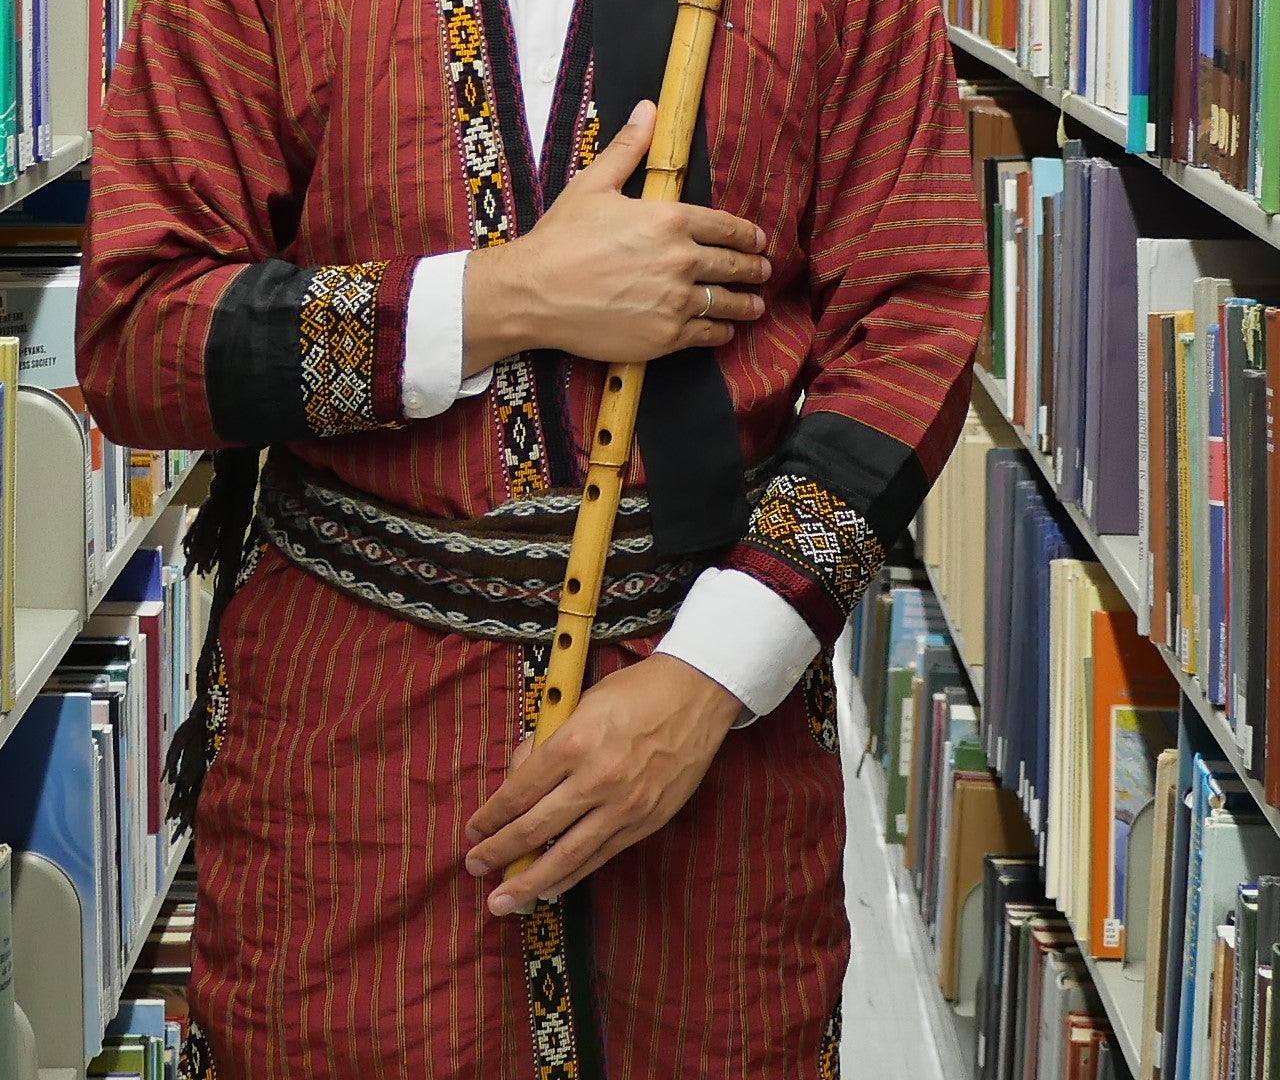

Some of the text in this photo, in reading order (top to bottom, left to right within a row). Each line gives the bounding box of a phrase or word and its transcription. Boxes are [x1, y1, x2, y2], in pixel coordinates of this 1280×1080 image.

[31, 357, 56, 370] SOCIETY
[1138, 331, 1147, 392] SHORTENING
[1139, 401, 1148, 461] STRUCTURES
[1139, 470, 1147, 481] IN
